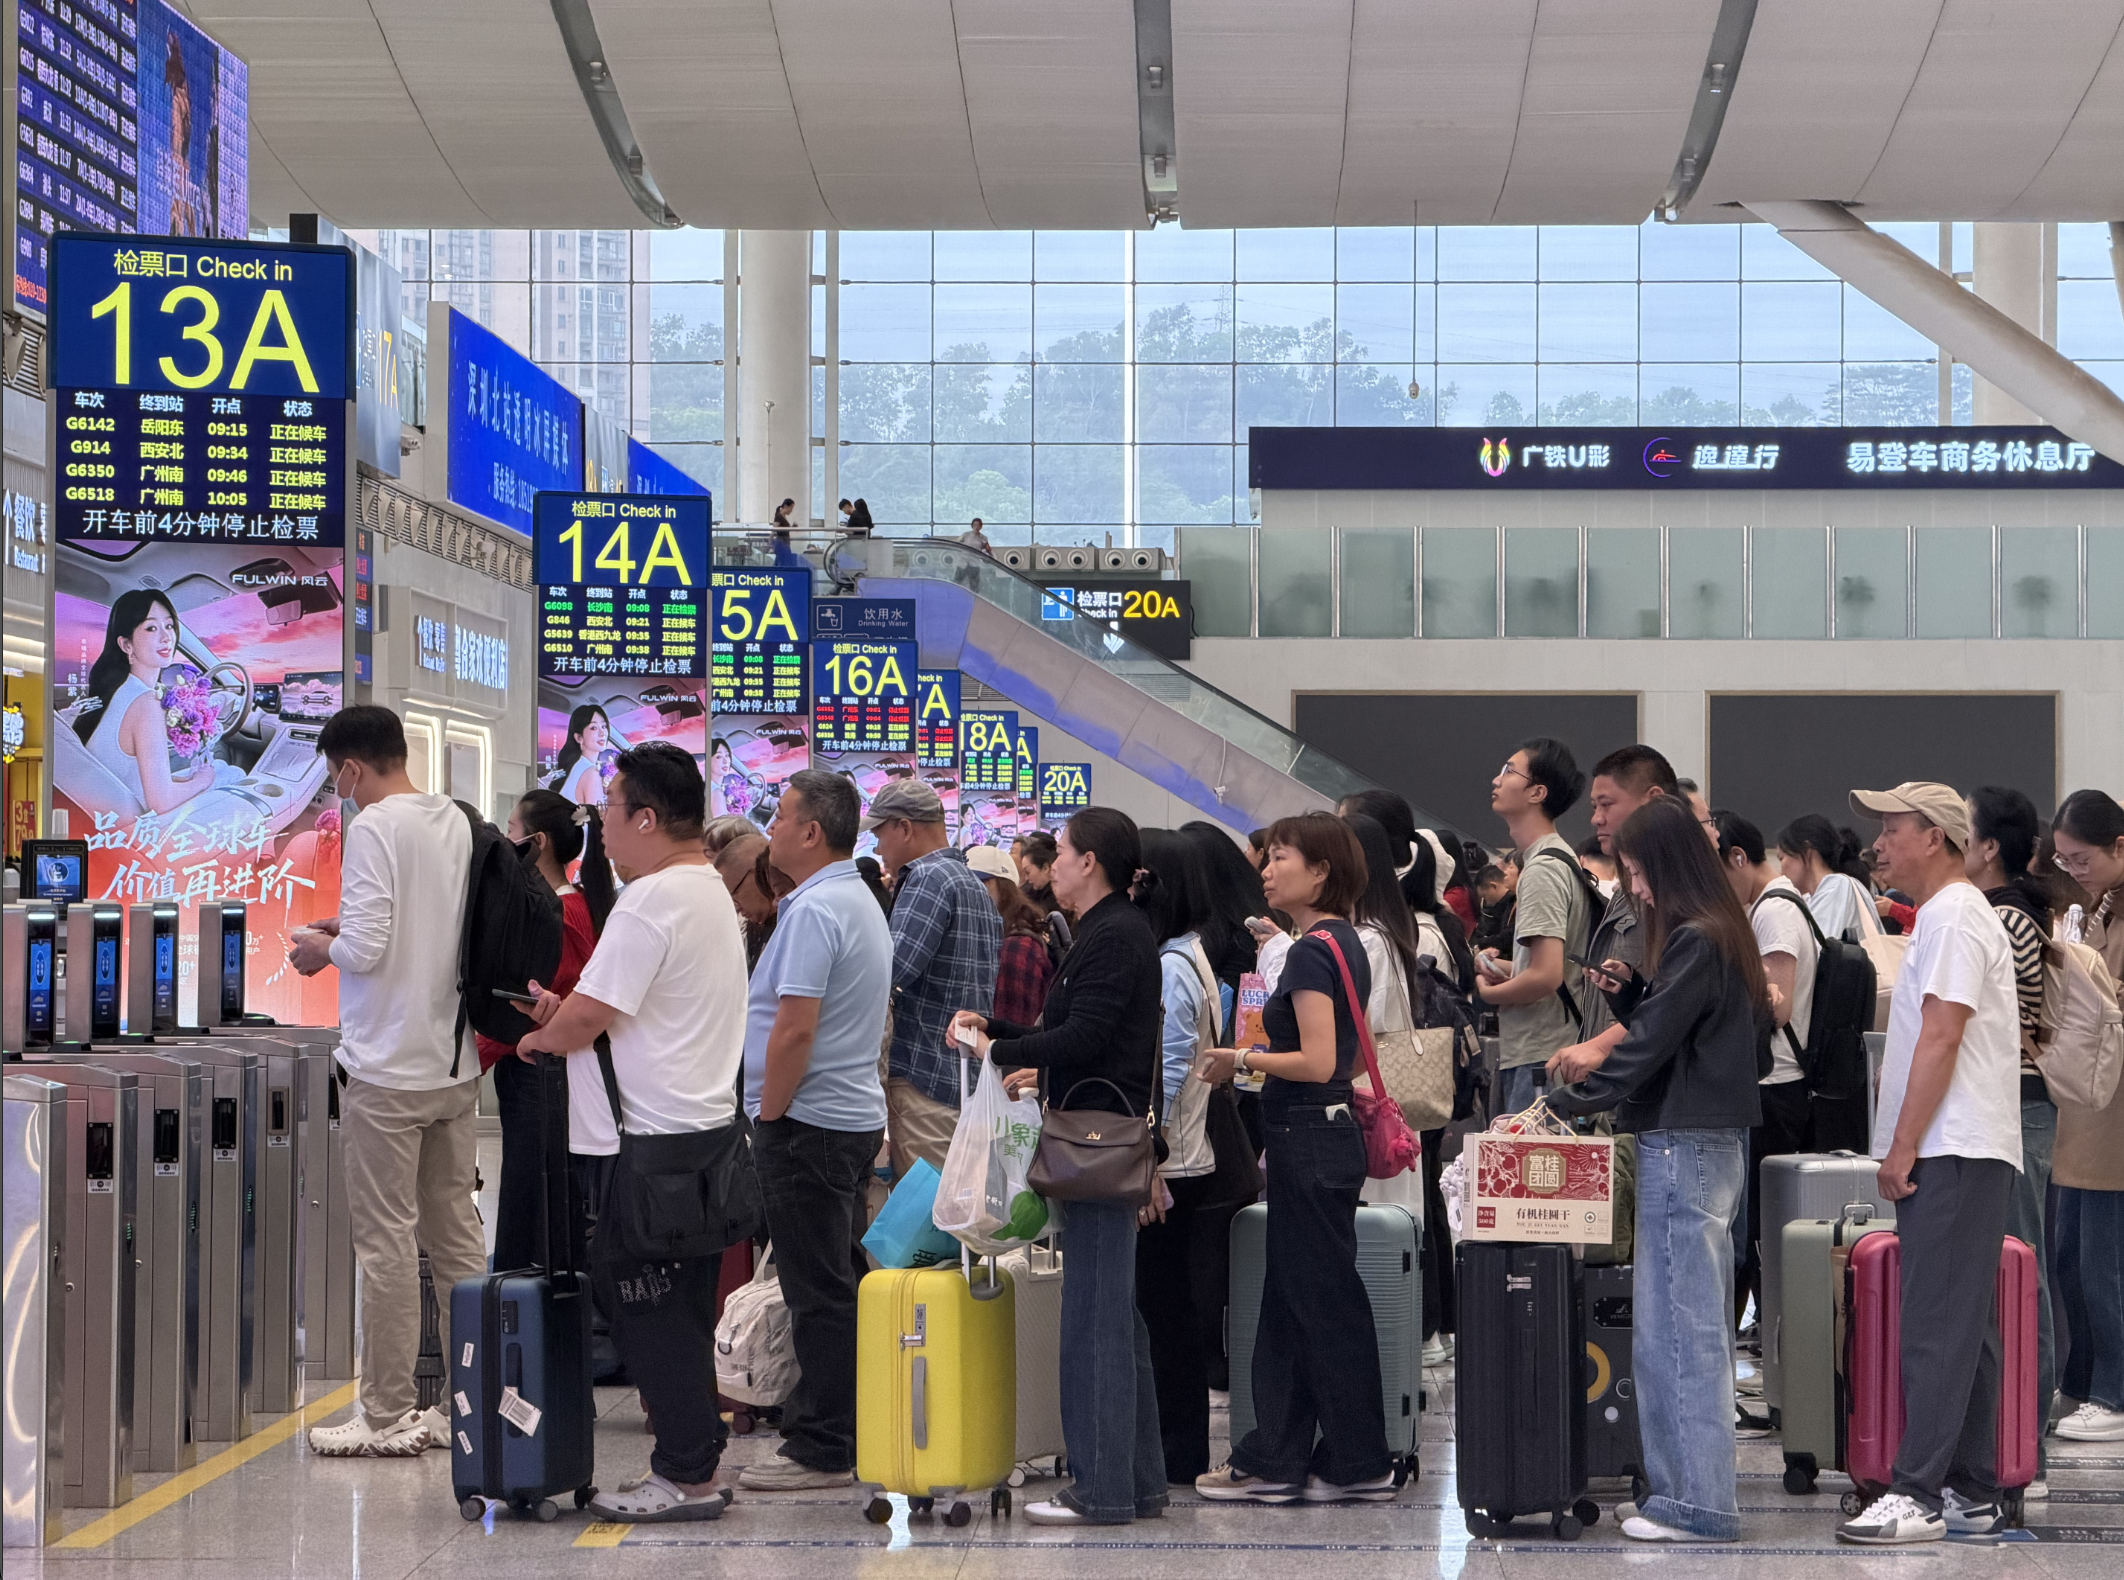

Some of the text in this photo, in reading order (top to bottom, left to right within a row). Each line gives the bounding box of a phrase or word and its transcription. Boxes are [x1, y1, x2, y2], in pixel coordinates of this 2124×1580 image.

[114, 249, 293, 281] 检票口 Check in
[91, 281, 320, 393] 13A
[74, 392, 313, 417] 车次 终到站 开点 状态
[66, 416, 327, 443] G6142 岳阳东 09:15 正在候车
[70, 440, 327, 465] G914 西安北 09:34 正在候车
[1521, 443, 1612, 469] 广铁U彩
[1846, 440, 2097, 472] 易登车商务休息厅
[65, 463, 327, 488] G6350 广州南 09:46 正在候车
[65, 486, 327, 511] G6518 广州南 10:05 正在候车
[572, 500, 676, 519] 检票口 Check in
[83, 508, 319, 540] 开车前4分钟停止检票
[558, 519, 693, 586] 14A
[231, 573, 328, 588] FULWIN 风云
[738, 574, 772, 586] Check
[774, 574, 784, 586] in
[549, 586, 688, 601] 车次 终到站 开点 状态
[544, 601, 697, 615] G6098 长沙南 09:08 正在检票
[864, 607, 903, 620] 饮用水
[1077, 589, 1181, 619] 检票口 20A
[1108, 608, 1118, 619] in
[547, 615, 697, 629] G846 西安北 09:21 正在候车
[720, 589, 799, 641] 5A
[858, 620, 909, 629] Drinking Water
[544, 629, 697, 643] G5639 香港西九龙 09:35 正在候车
[544, 643, 697, 657] G6510 广州南 09:38 正在候车
[832, 643, 898, 655] 检票口 Check in
[554, 657, 692, 675] 开车前4分钟停止检票
[825, 654, 908, 697] 16A
[936, 674, 943, 682] in
[640, 694, 697, 703] FULWIN 风云
[711, 699, 798, 713] 前4分钟停止检票
[918, 683, 952, 720] A
[979, 714, 998, 722] Check
[755, 728, 787, 736] FULWIN
[960, 722, 1012, 752] 18A
[822, 739, 908, 752] 开车前4分钟停止检票
[1017, 736, 1033, 764] A
[1044, 771, 1087, 792] 20A
[84, 804, 289, 864] 品质全球车
[100, 858, 317, 909] 价值再进阶
[1528, 1154, 1560, 1172] 富桂
[1528, 1170, 1560, 1188] 团圆
